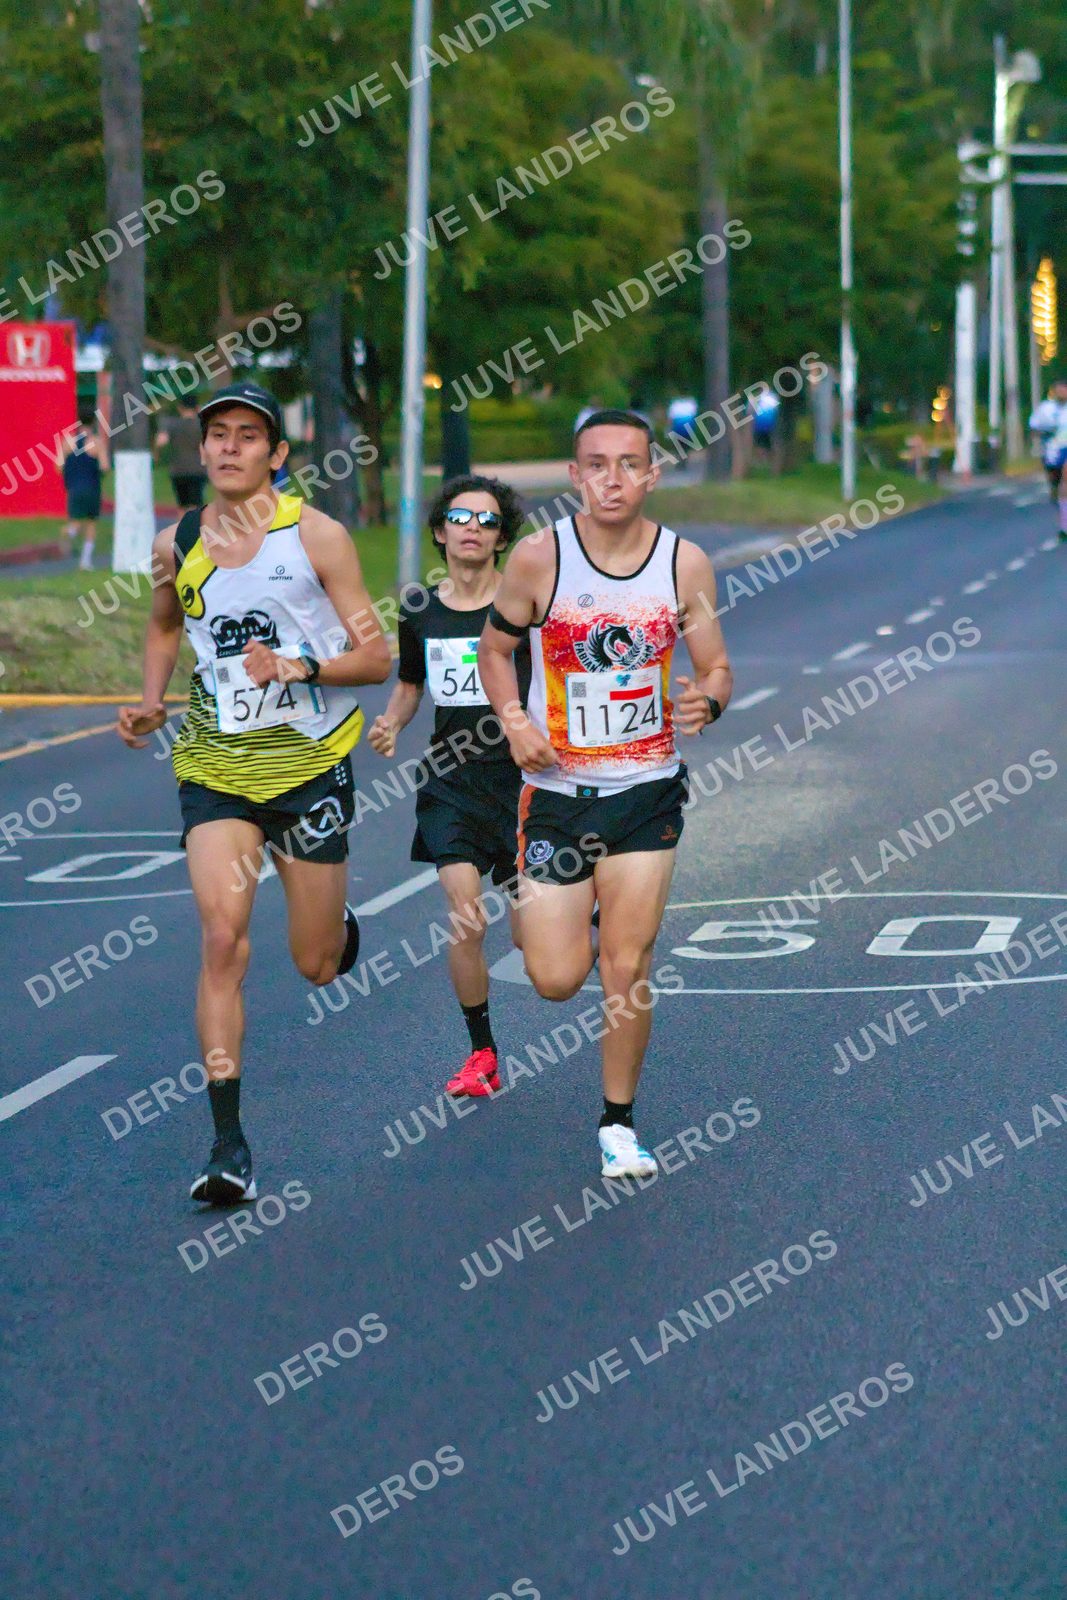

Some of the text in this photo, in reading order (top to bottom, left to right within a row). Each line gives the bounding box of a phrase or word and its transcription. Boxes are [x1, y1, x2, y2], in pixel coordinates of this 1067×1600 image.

[574, 642, 598, 673] FABIAN
[441, 667, 480, 697] 54
[233, 681, 297, 722] 574
[575, 695, 658, 737] 1124
